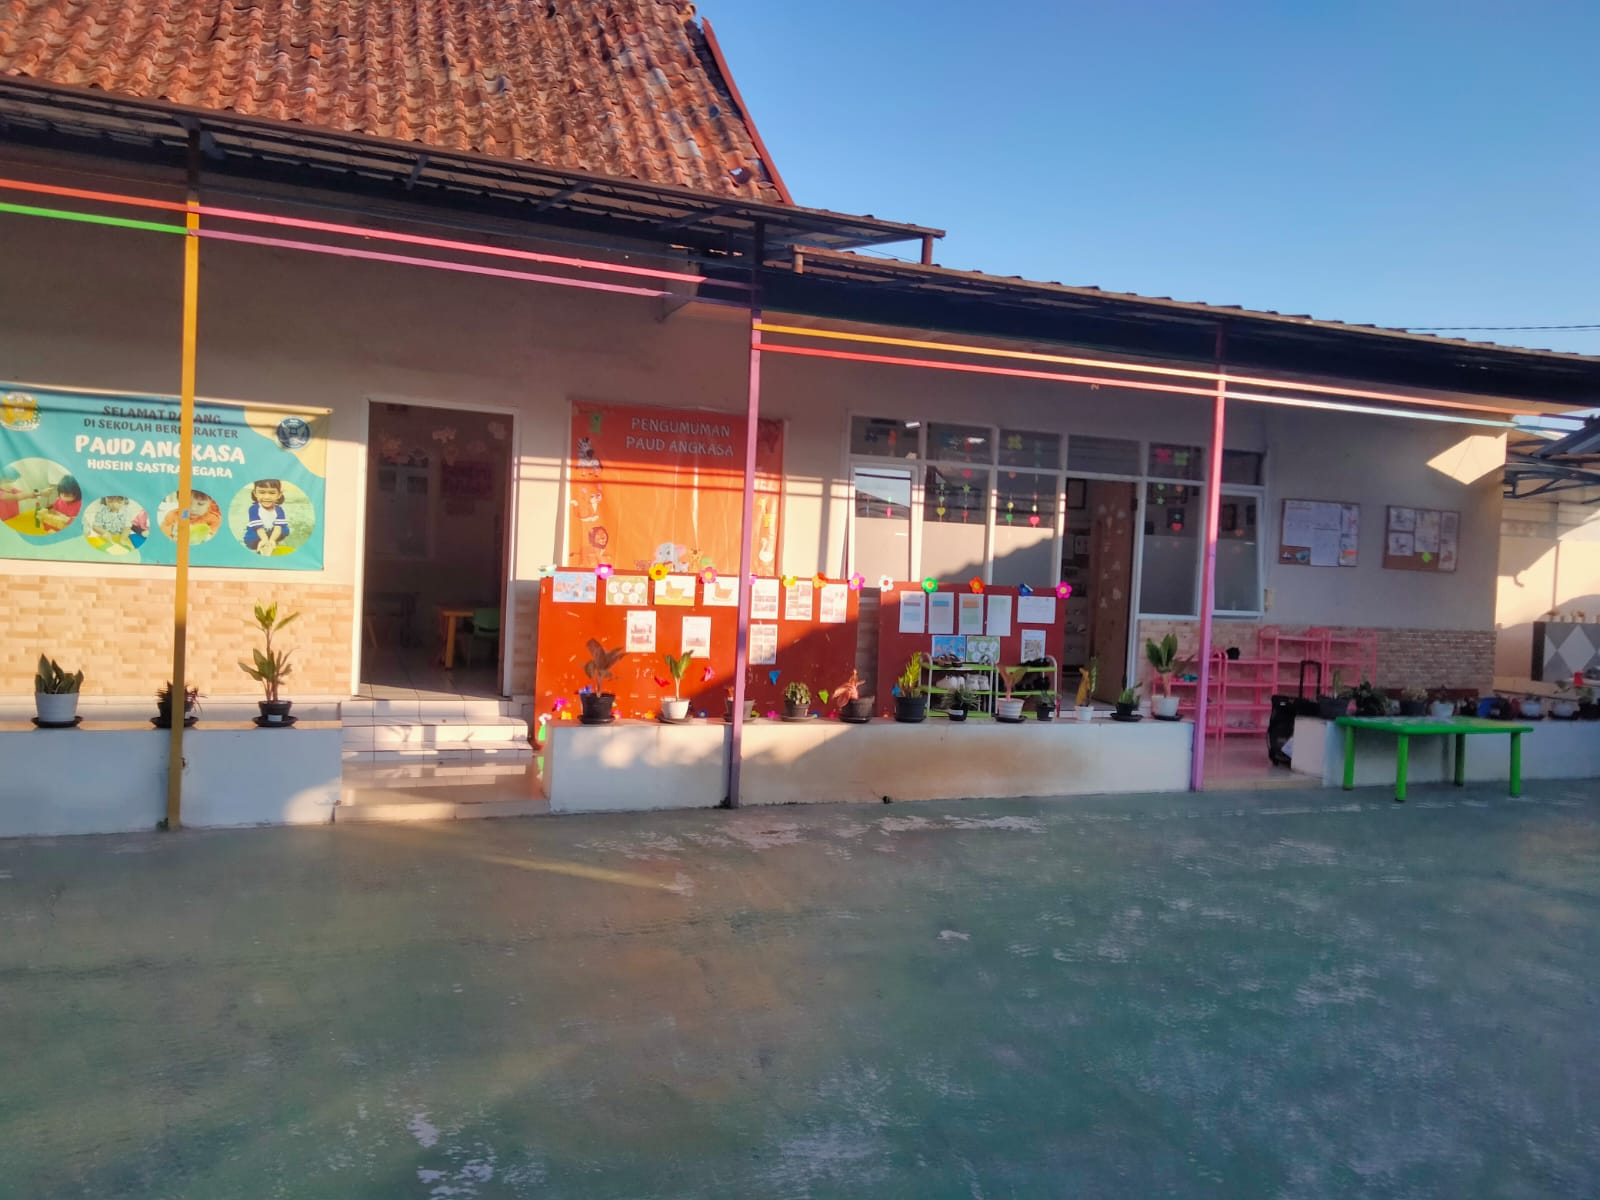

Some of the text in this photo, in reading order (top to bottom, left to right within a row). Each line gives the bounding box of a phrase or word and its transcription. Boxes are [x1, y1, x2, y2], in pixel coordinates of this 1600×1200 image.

[103, 406, 221, 425] SELAMAT DANG
[84, 418, 238, 438] DI SEKOLAH BERRAKTER
[631, 417, 730, 437] PENGUMUMAN
[75, 434, 136, 455] PAUD
[625, 435, 734, 456] PAUD ANGKASA
[87, 459, 233, 478] HUSEIN SASTRAEGARA
